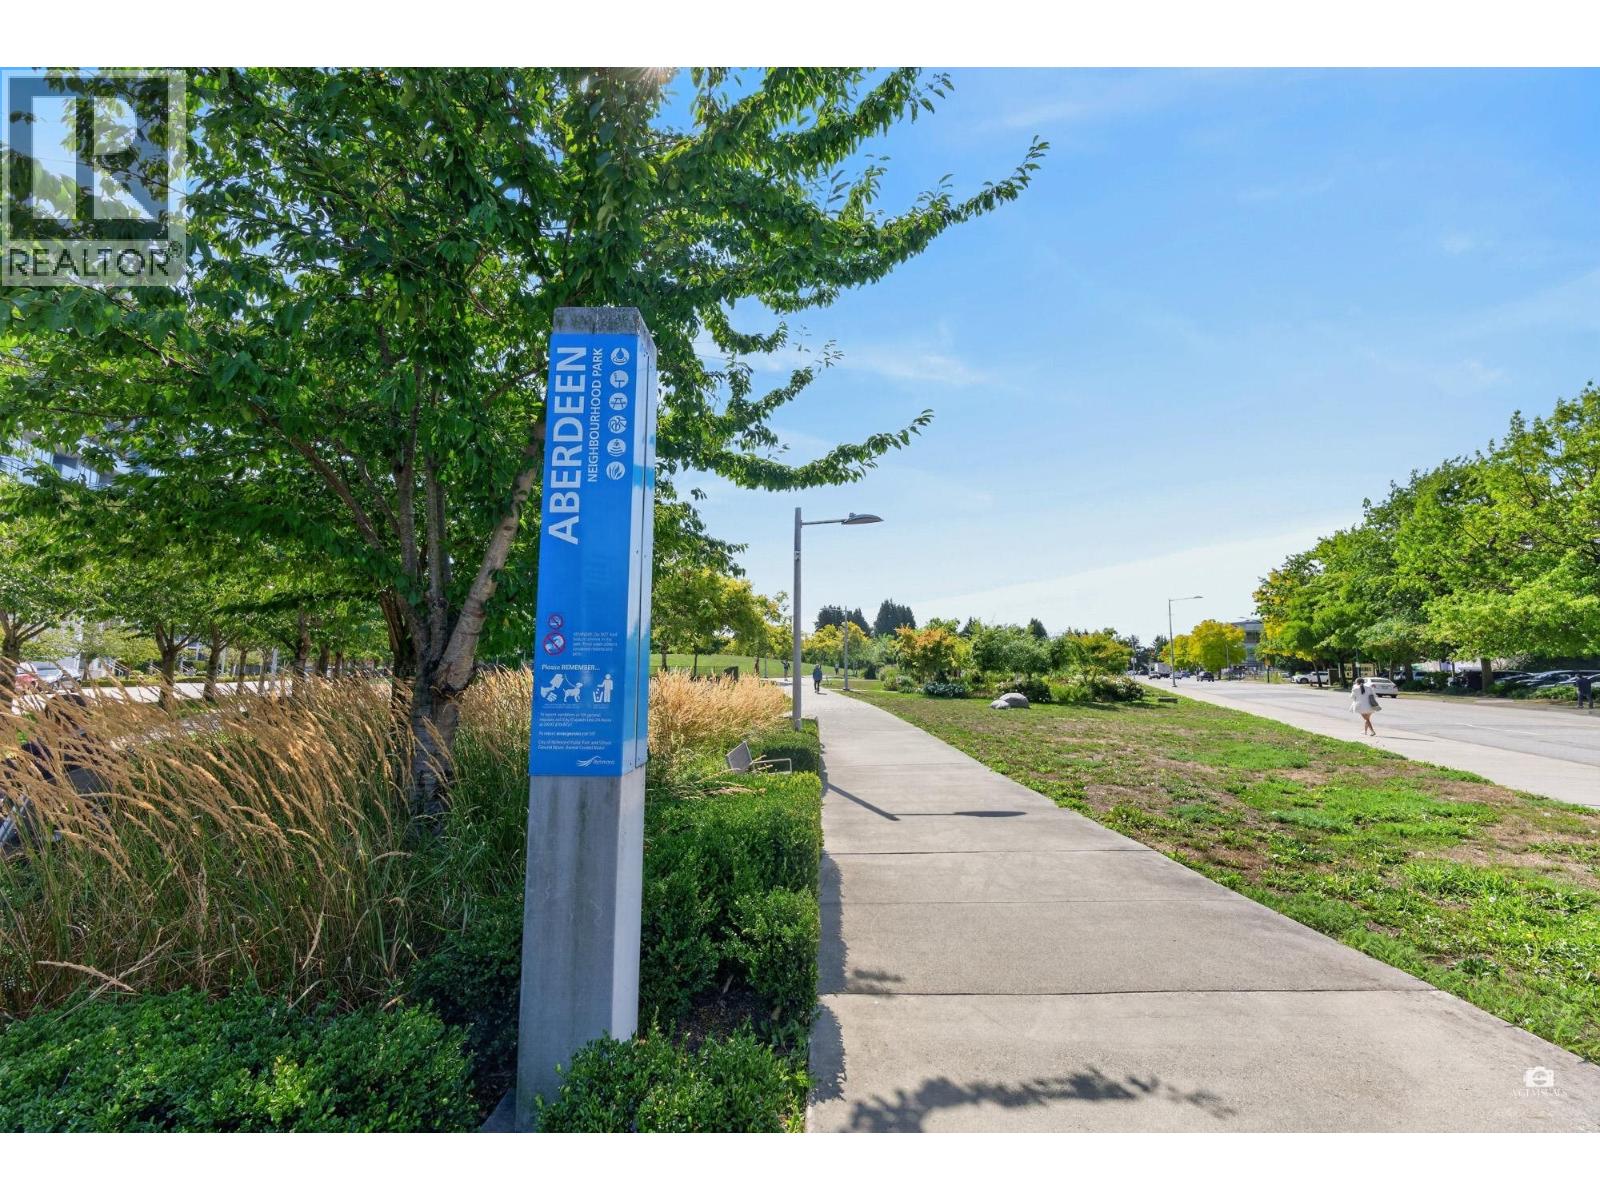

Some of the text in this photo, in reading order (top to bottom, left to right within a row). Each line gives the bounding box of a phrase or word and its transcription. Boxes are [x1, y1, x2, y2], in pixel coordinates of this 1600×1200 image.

[548, 346, 587, 545] ABERDEEN
[587, 347, 603, 482] NEIGHBOURHOOD PARK
